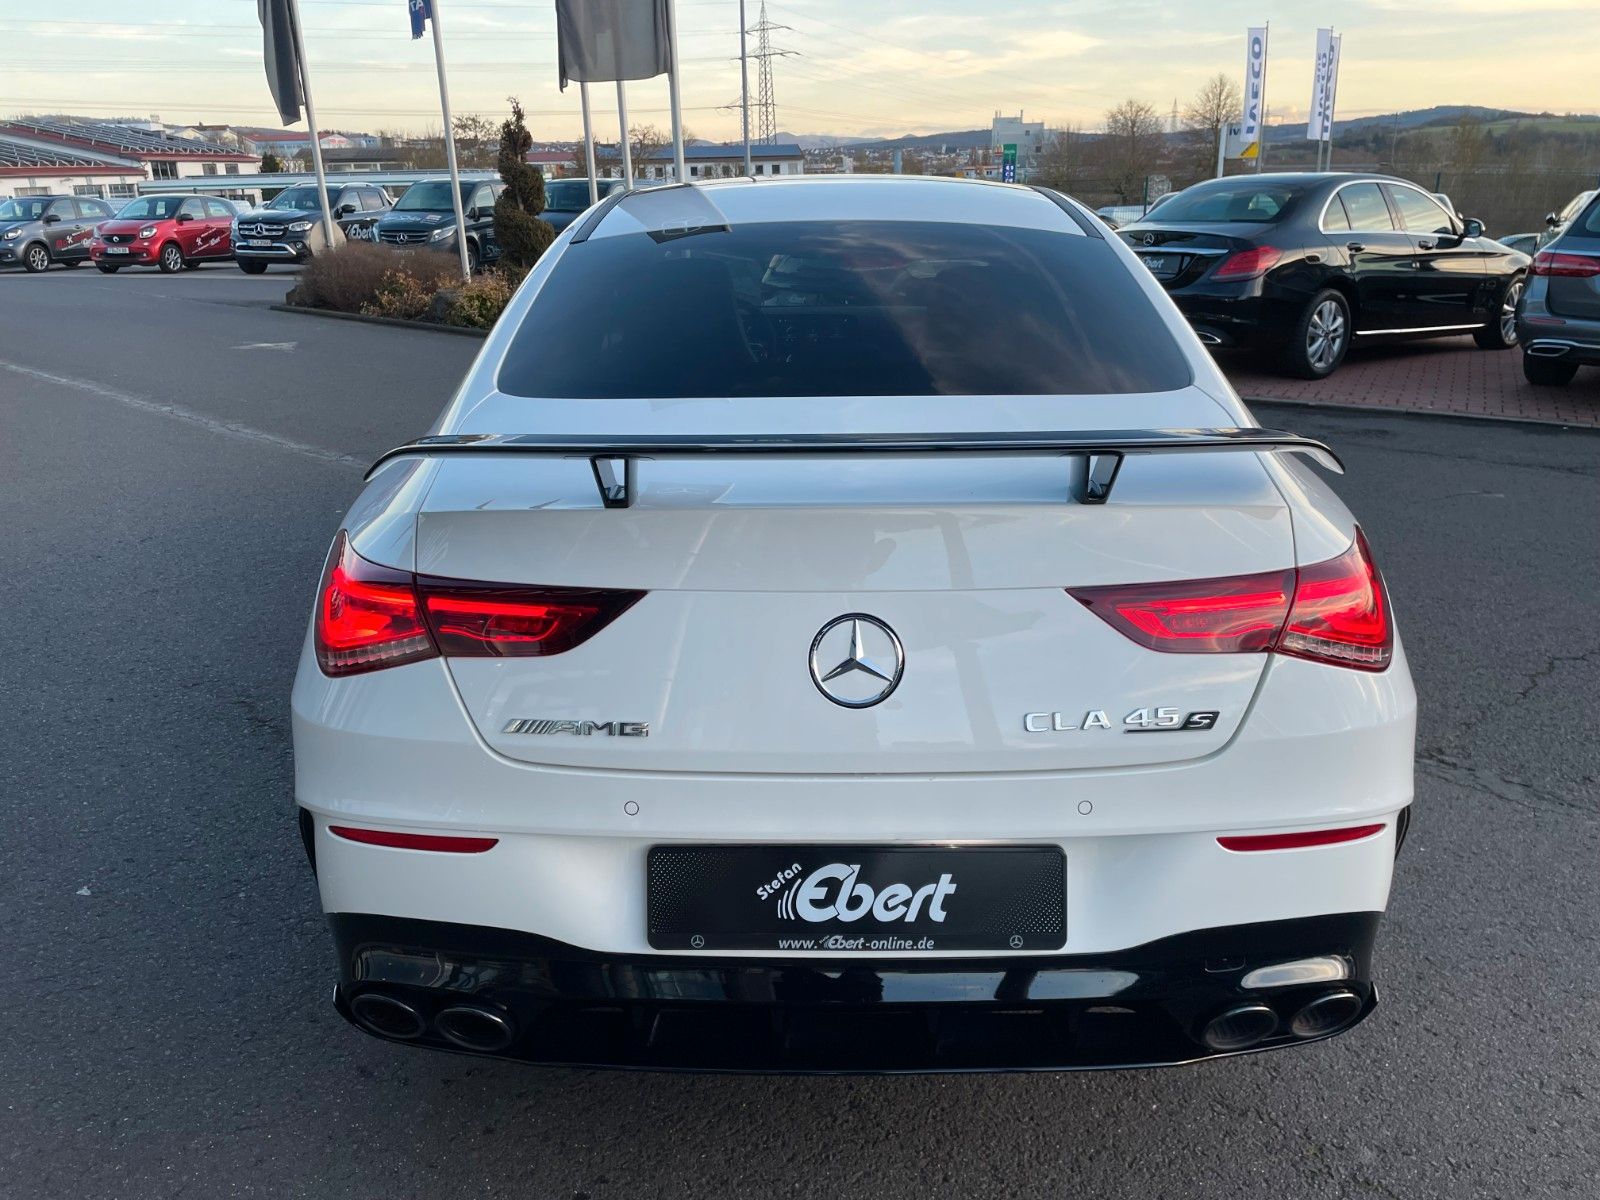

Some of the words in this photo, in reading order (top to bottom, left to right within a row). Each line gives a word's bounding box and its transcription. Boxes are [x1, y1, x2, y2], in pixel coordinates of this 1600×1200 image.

[1246, 36, 1261, 134] IVECO
[546, 719, 649, 737] AMG
[1024, 709, 1112, 732] CLA
[756, 862, 802, 901] Stefan
[795, 863, 957, 923] Ebert
